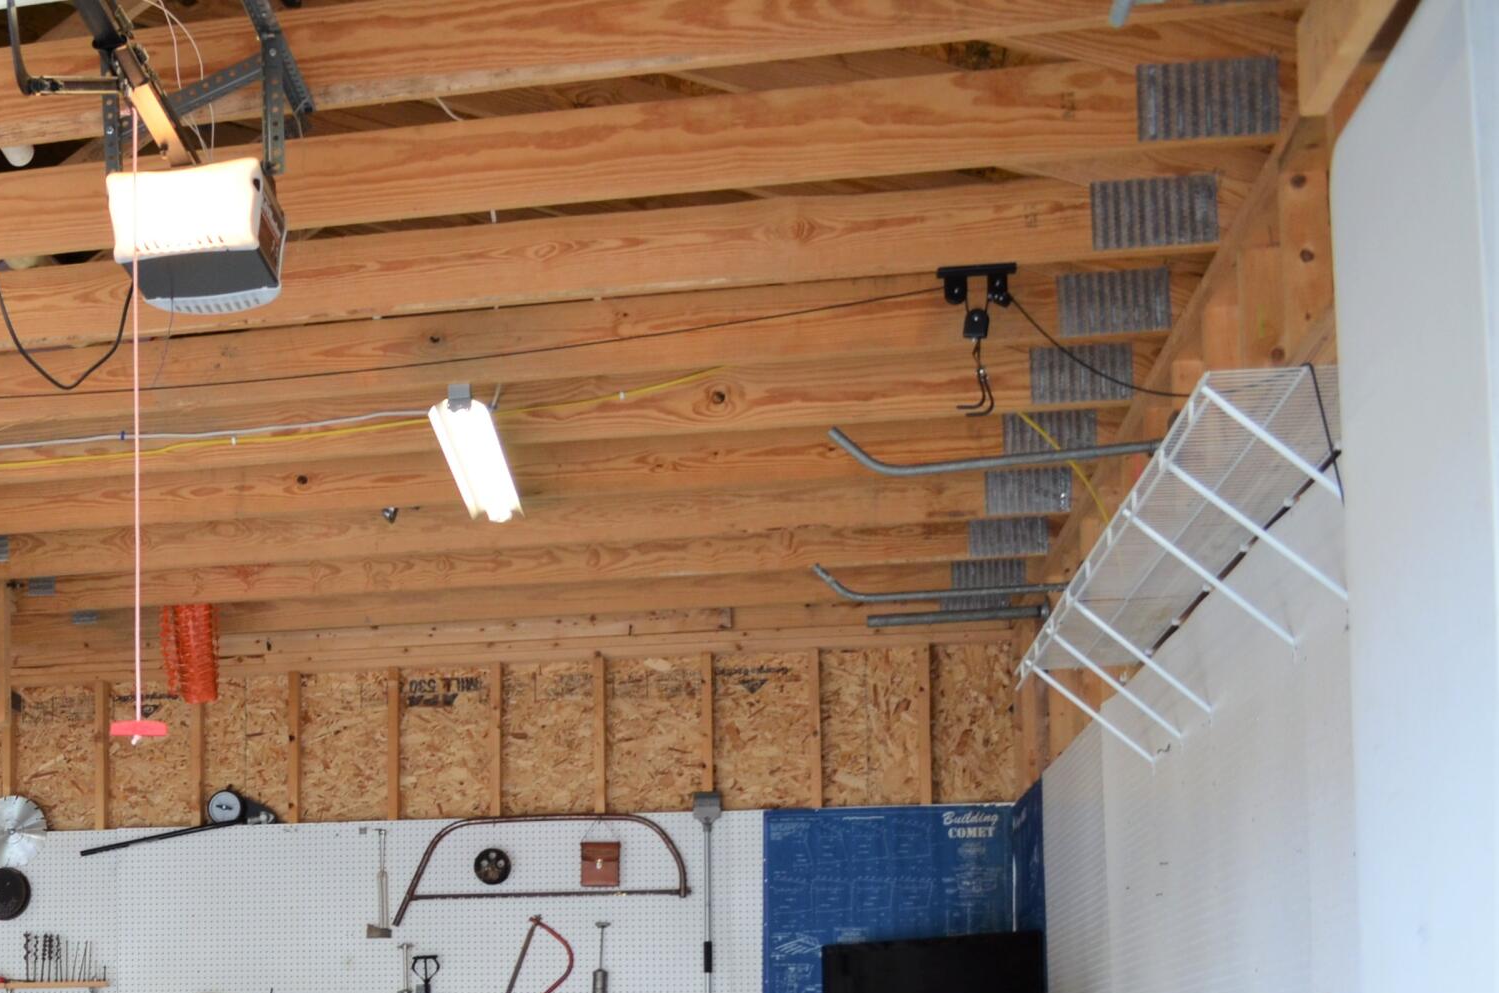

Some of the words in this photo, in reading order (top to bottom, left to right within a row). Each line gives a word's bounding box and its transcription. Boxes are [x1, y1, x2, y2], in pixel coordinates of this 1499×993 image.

[409, 678, 437, 694] 530
[942, 810, 999, 826] Building
[948, 826, 996, 839] COMET
